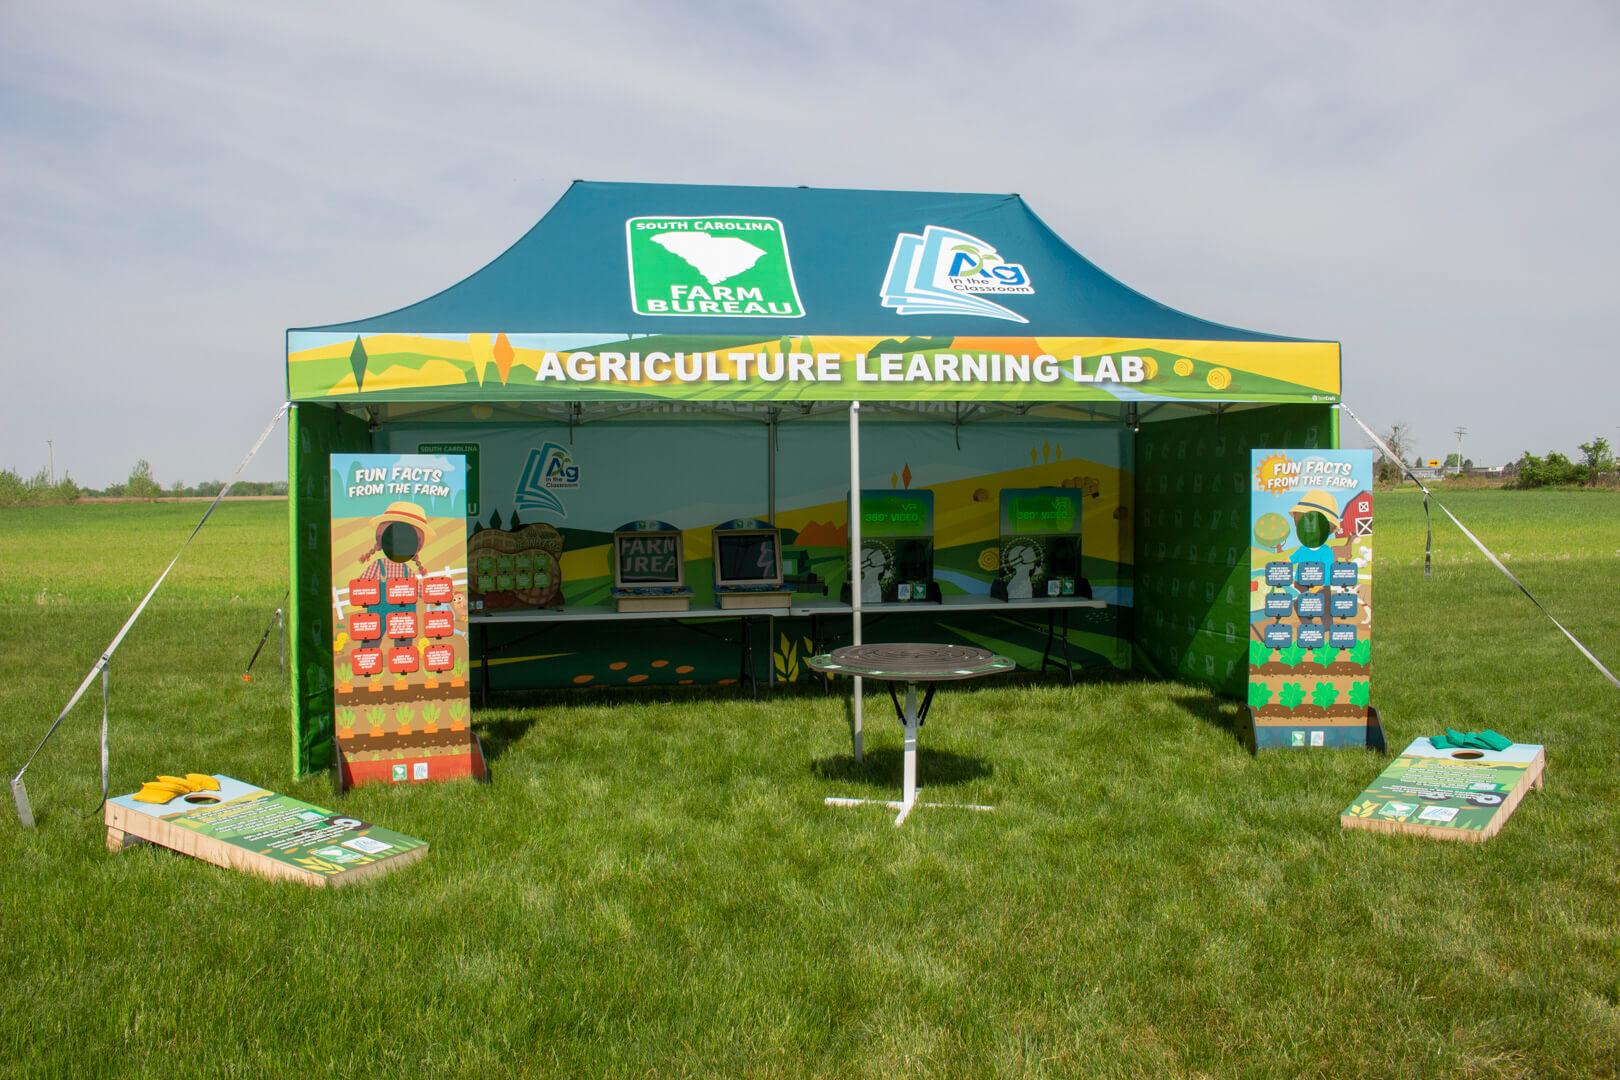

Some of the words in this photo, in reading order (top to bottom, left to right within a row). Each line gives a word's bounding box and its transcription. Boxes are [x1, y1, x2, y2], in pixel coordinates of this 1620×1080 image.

[636, 221, 688, 231] SOUTH
[694, 220, 775, 232] CAROLINA
[947, 251, 1025, 285] Ag
[949, 276, 961, 285] in
[963, 276, 989, 286] the
[670, 285, 764, 302] FARM
[953, 284, 1030, 294] Classroom
[646, 299, 793, 316] BUREAU
[535, 351, 842, 382] AGRICULTURE
[855, 353, 1060, 383] LEARNING
[1072, 355, 1146, 383] LAB
[444, 445, 478, 453] CAROLINA
[355, 468, 387, 483] FUN
[392, 467, 443, 483] FACTS
[545, 457, 579, 483] Ag
[1273, 462, 1302, 475] FUN
[1305, 461, 1353, 475] FACTS
[1267, 476, 1299, 489] FROM
[1302, 476, 1323, 486] THE
[1326, 477, 1358, 489] FARM
[349, 483, 384, 498] FROM
[388, 483, 411, 494] THE
[414, 484, 450, 497] FARM
